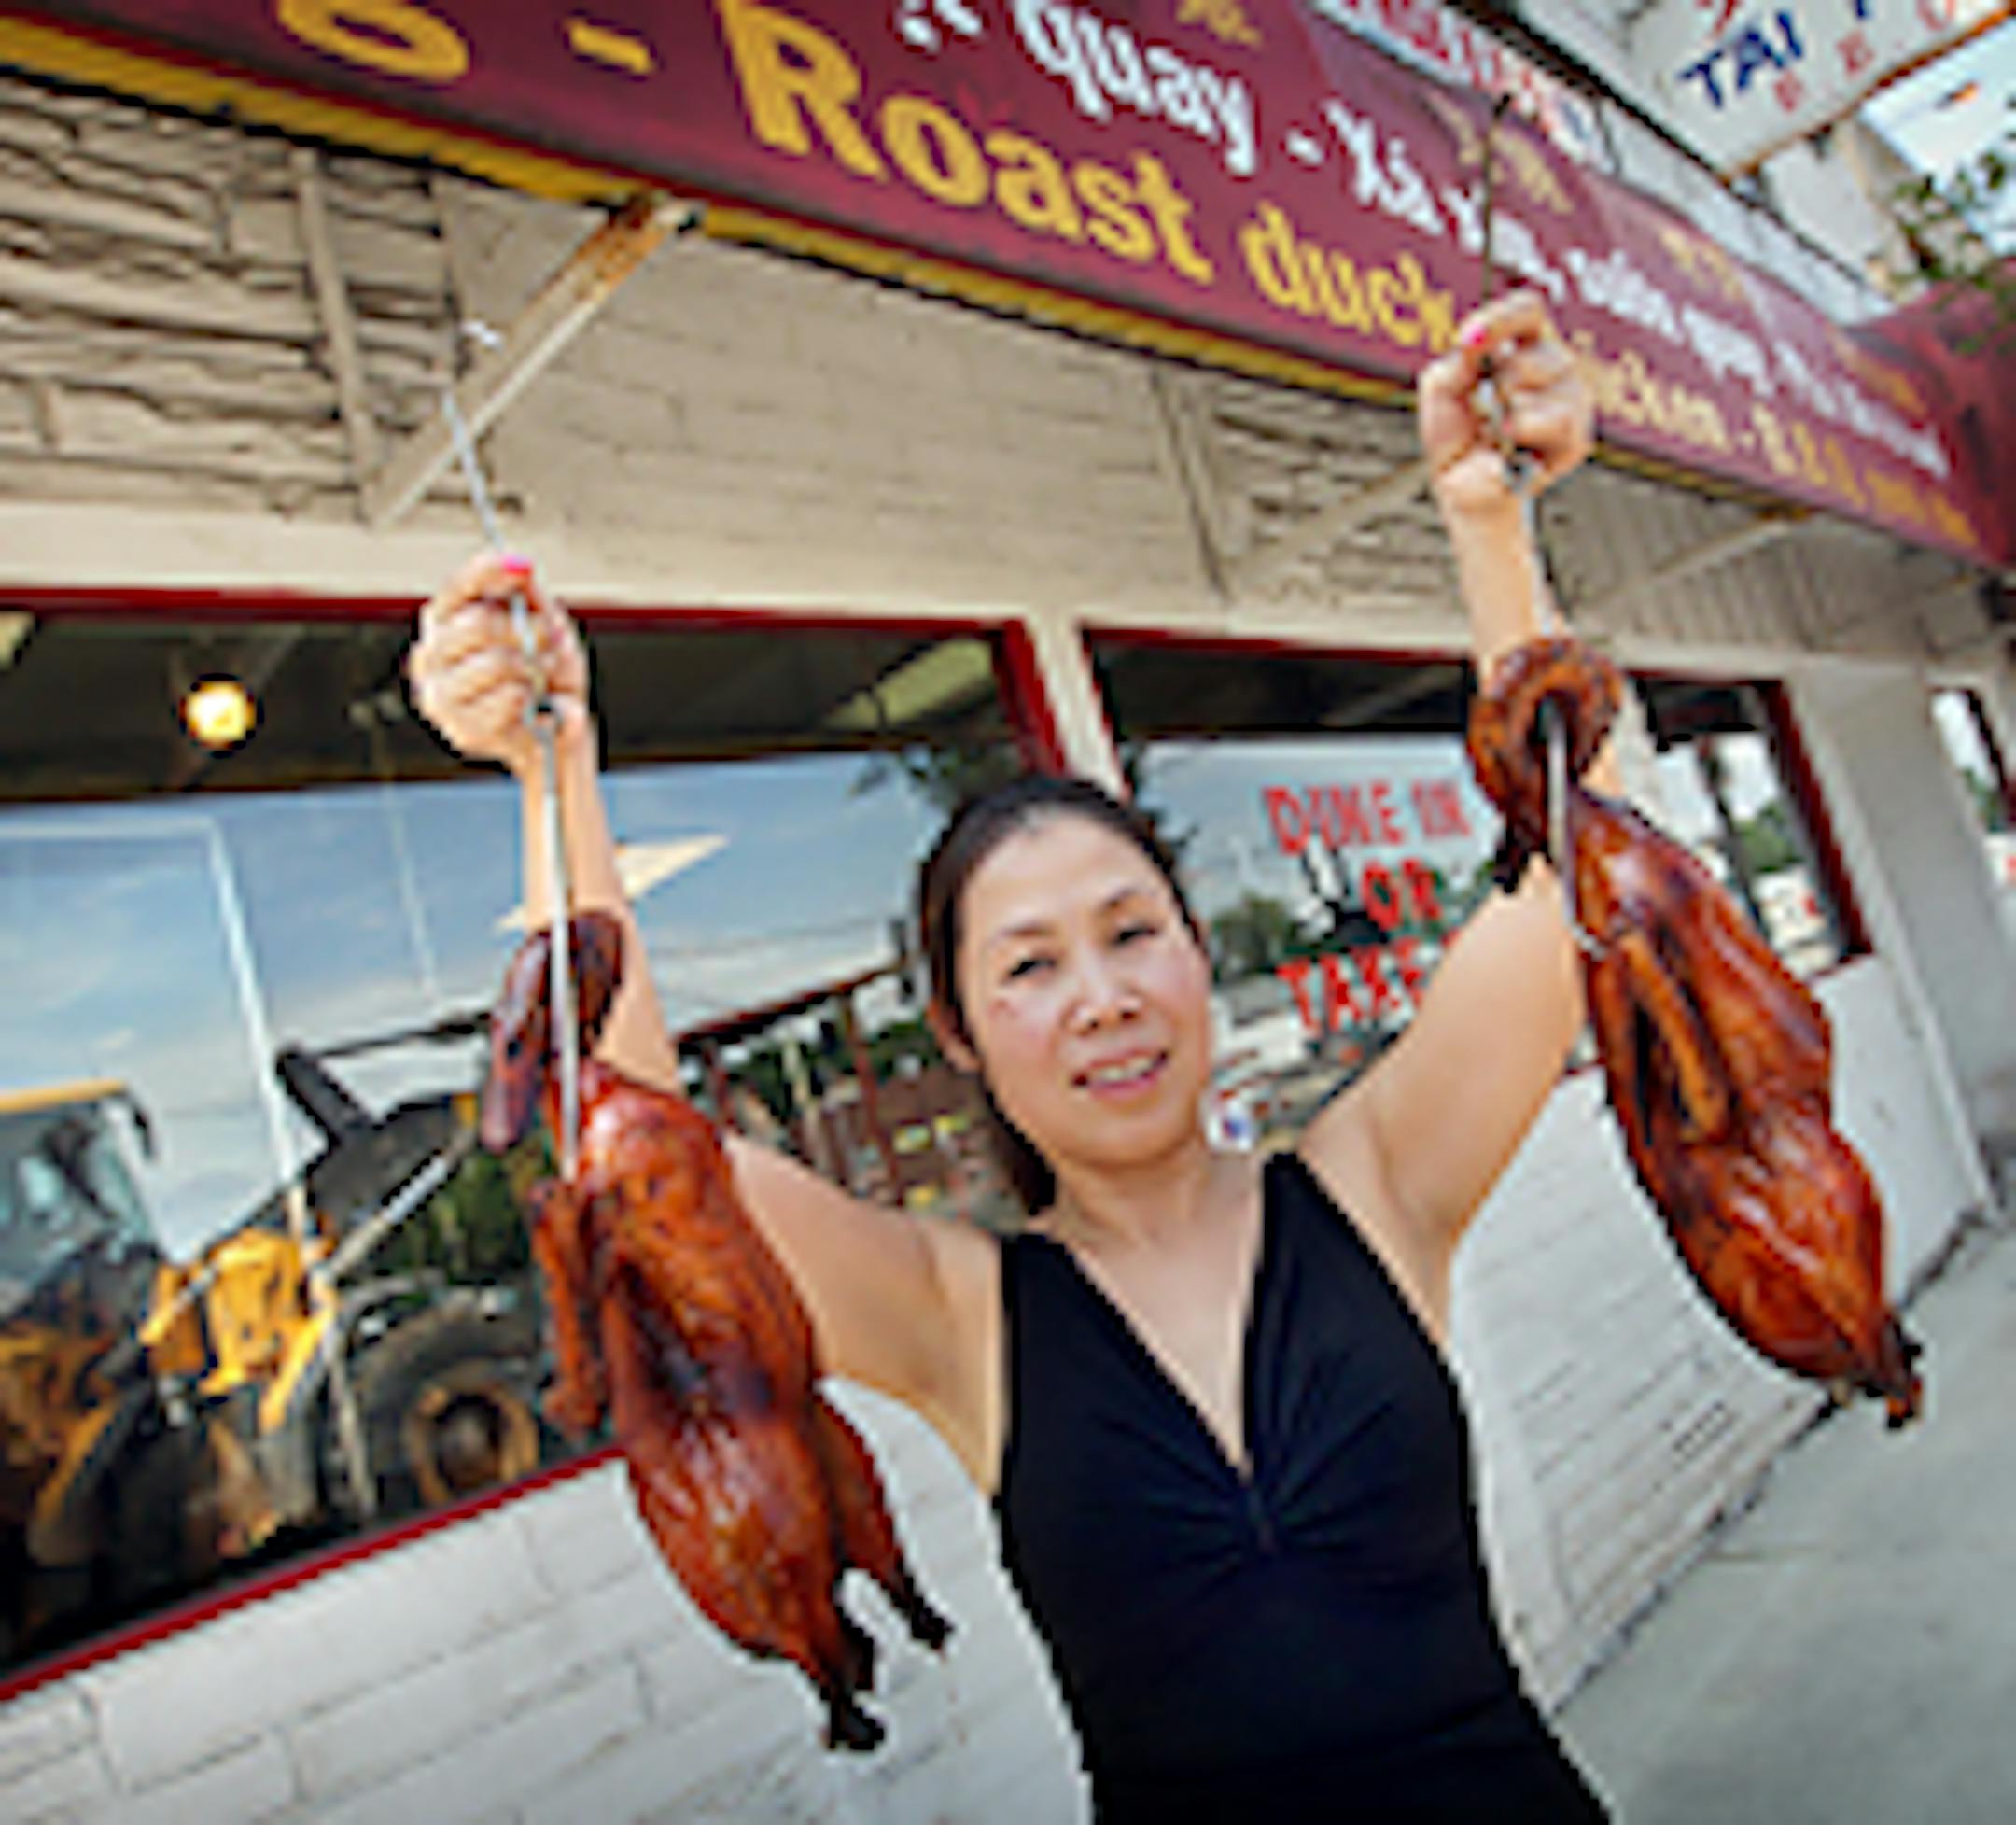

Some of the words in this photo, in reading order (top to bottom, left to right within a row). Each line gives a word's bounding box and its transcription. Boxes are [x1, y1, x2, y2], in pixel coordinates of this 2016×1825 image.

[1014, 0, 1256, 175] quay
[1674, 8, 1804, 110] TAI
[719, 0, 1215, 283] Roast
[1237, 199, 1457, 355] duck
[1262, 780, 1406, 855] DINE
[1410, 777, 1474, 838] IN
[1362, 856, 1444, 931] OR
